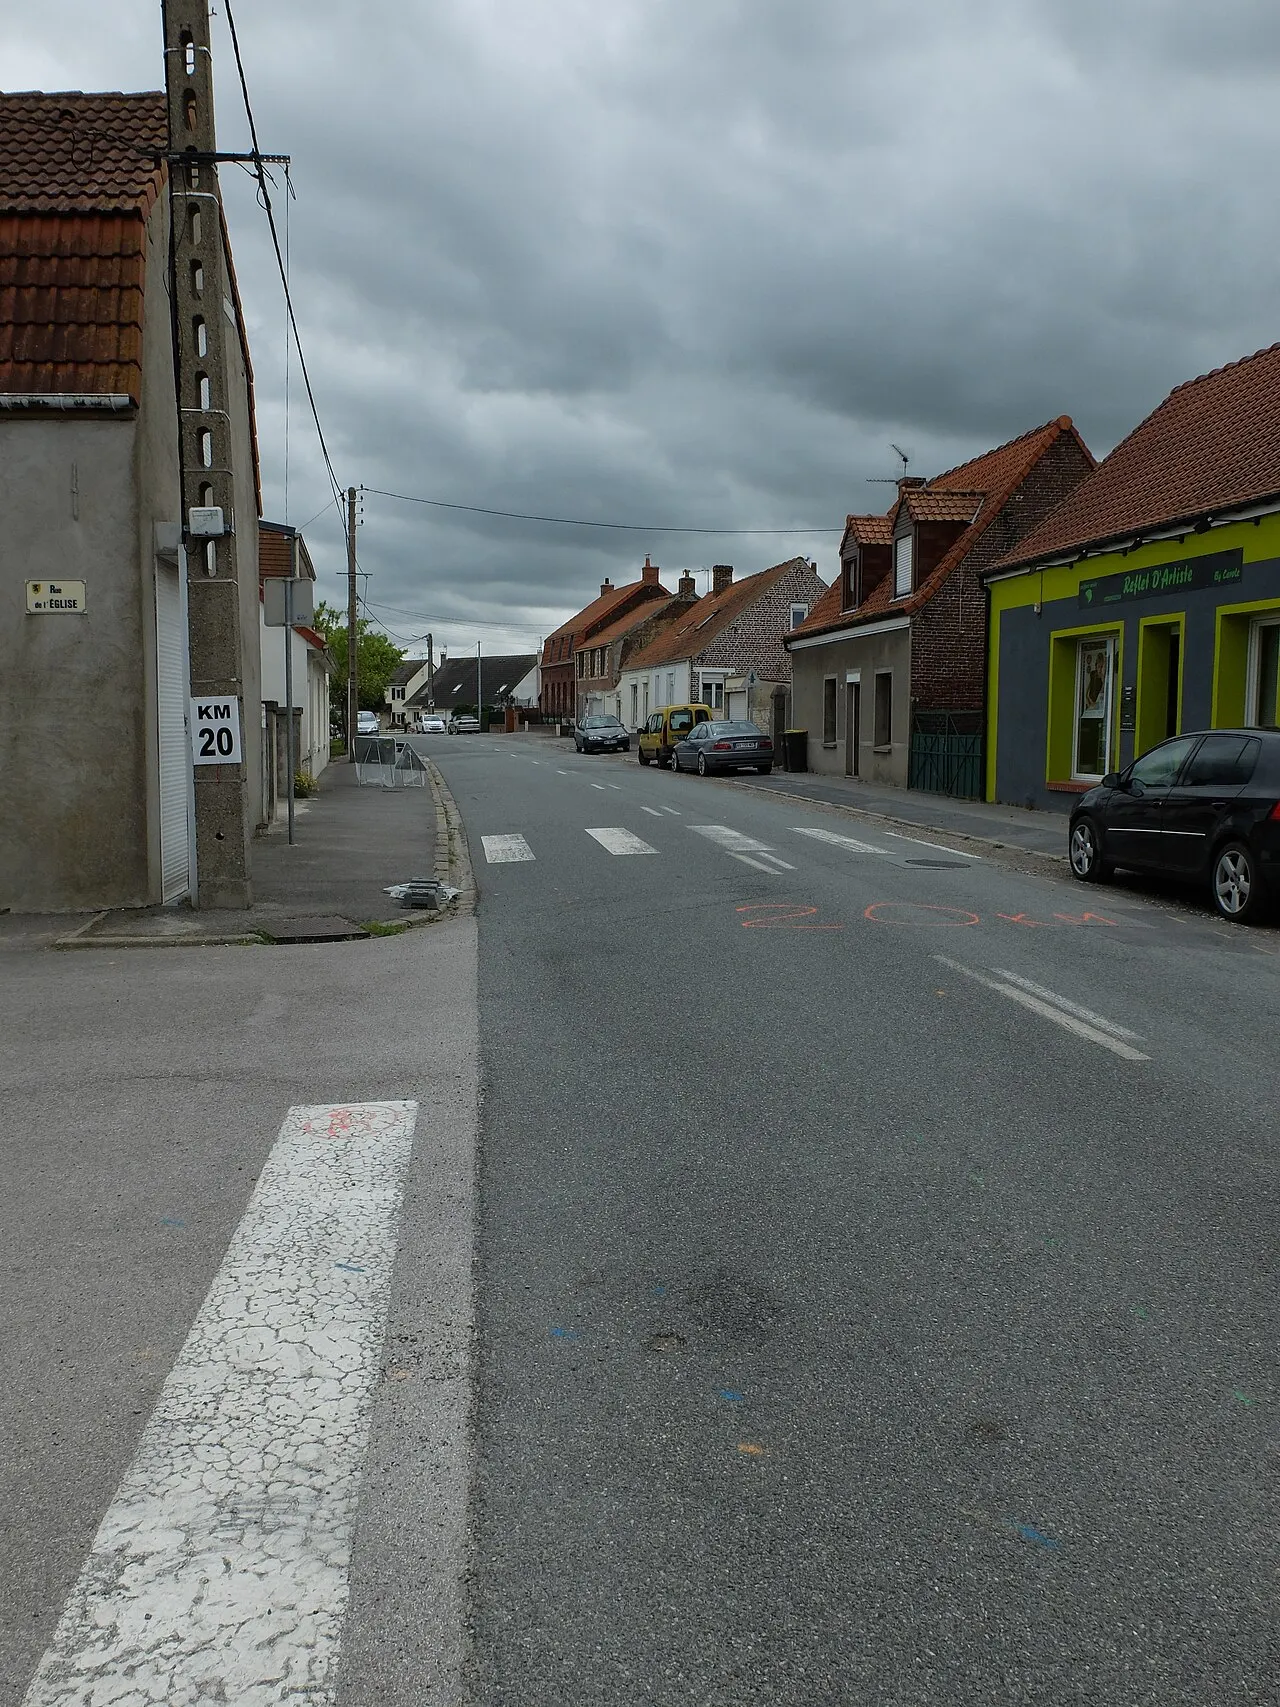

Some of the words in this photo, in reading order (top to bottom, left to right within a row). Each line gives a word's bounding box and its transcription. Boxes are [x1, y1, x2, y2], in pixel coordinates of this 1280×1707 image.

[1123, 574, 1149, 595] Reflet
[1151, 565, 1193, 589] D'Artiste
[1214, 571, 1222, 582] By
[49, 584, 62, 594] Rue
[197, 704, 231, 720] KM
[198, 727, 234, 757] 20
